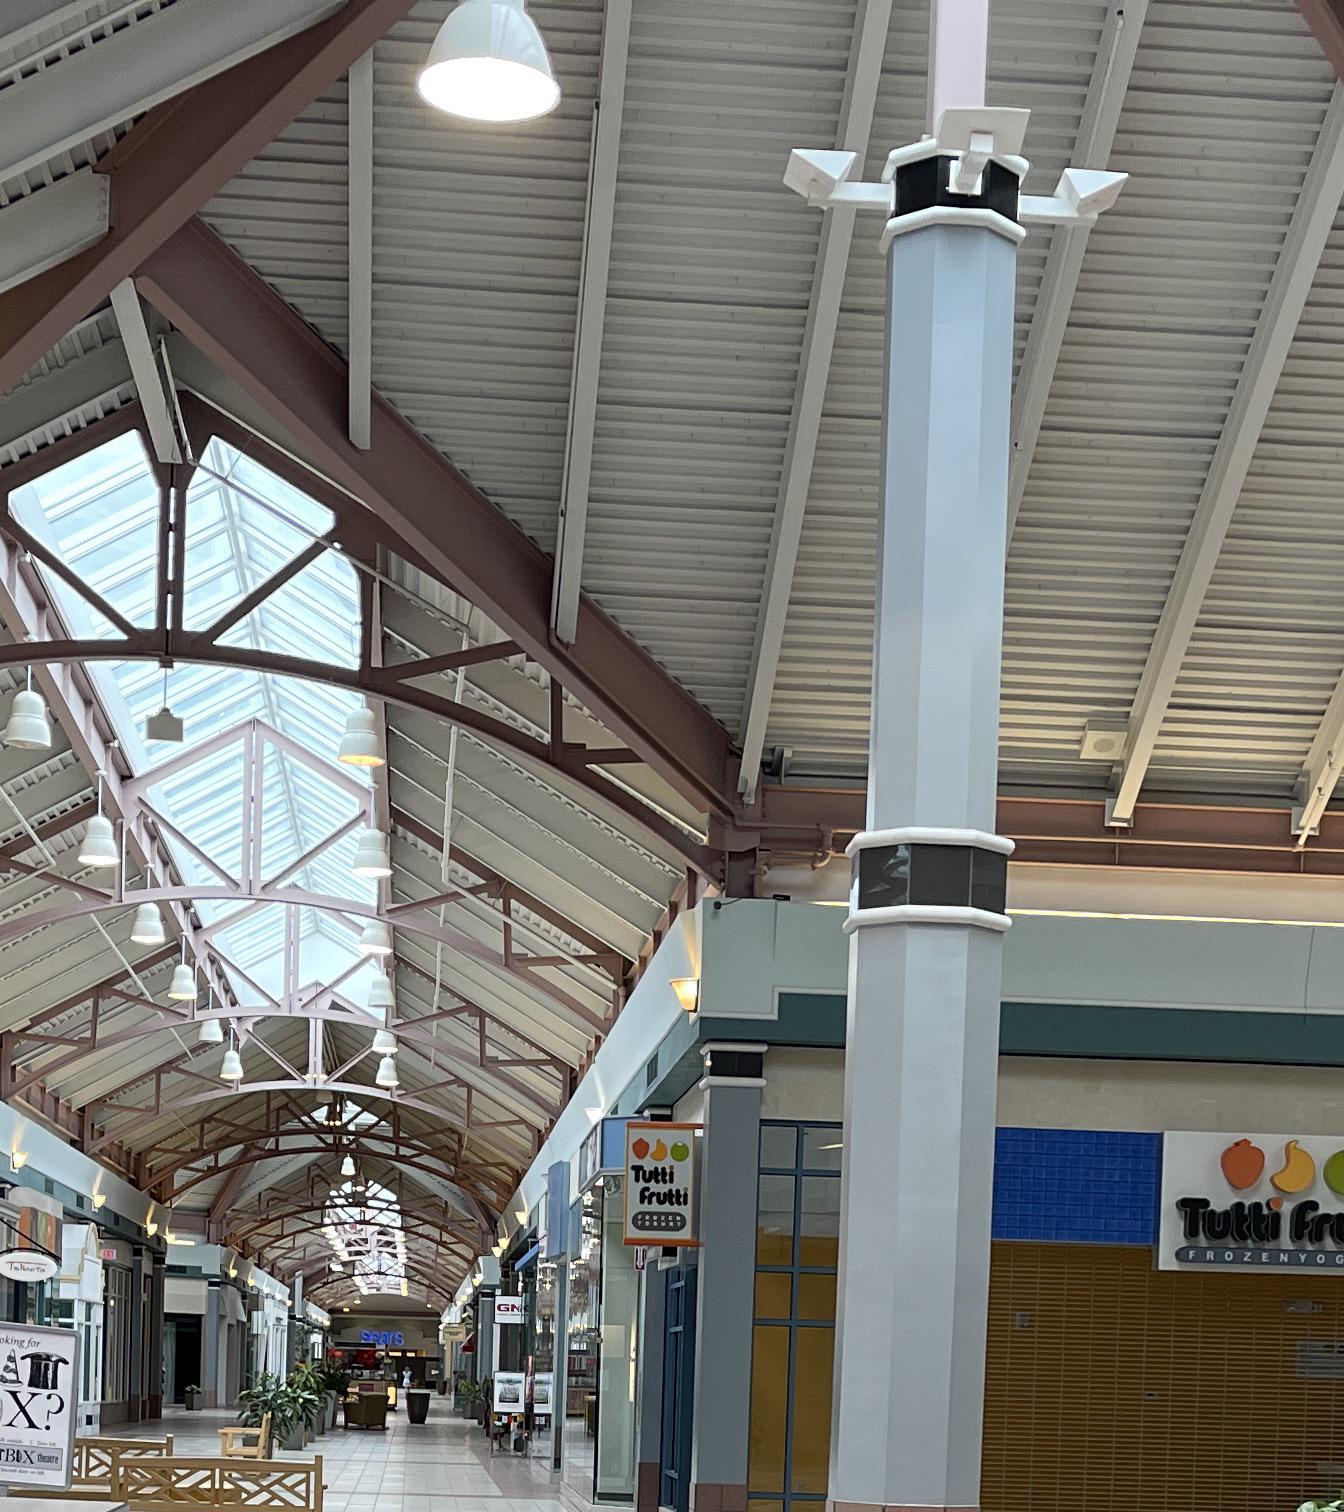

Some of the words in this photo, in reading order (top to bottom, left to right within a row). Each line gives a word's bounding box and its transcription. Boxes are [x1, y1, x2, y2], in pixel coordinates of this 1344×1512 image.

[631, 1164, 675, 1184] Tutti
[639, 1186, 689, 1206] Frutti
[1176, 1196, 1284, 1243] Tutti
[1188, 1251, 1289, 1264] FROZEN
[25, 1337, 42, 1350] for
